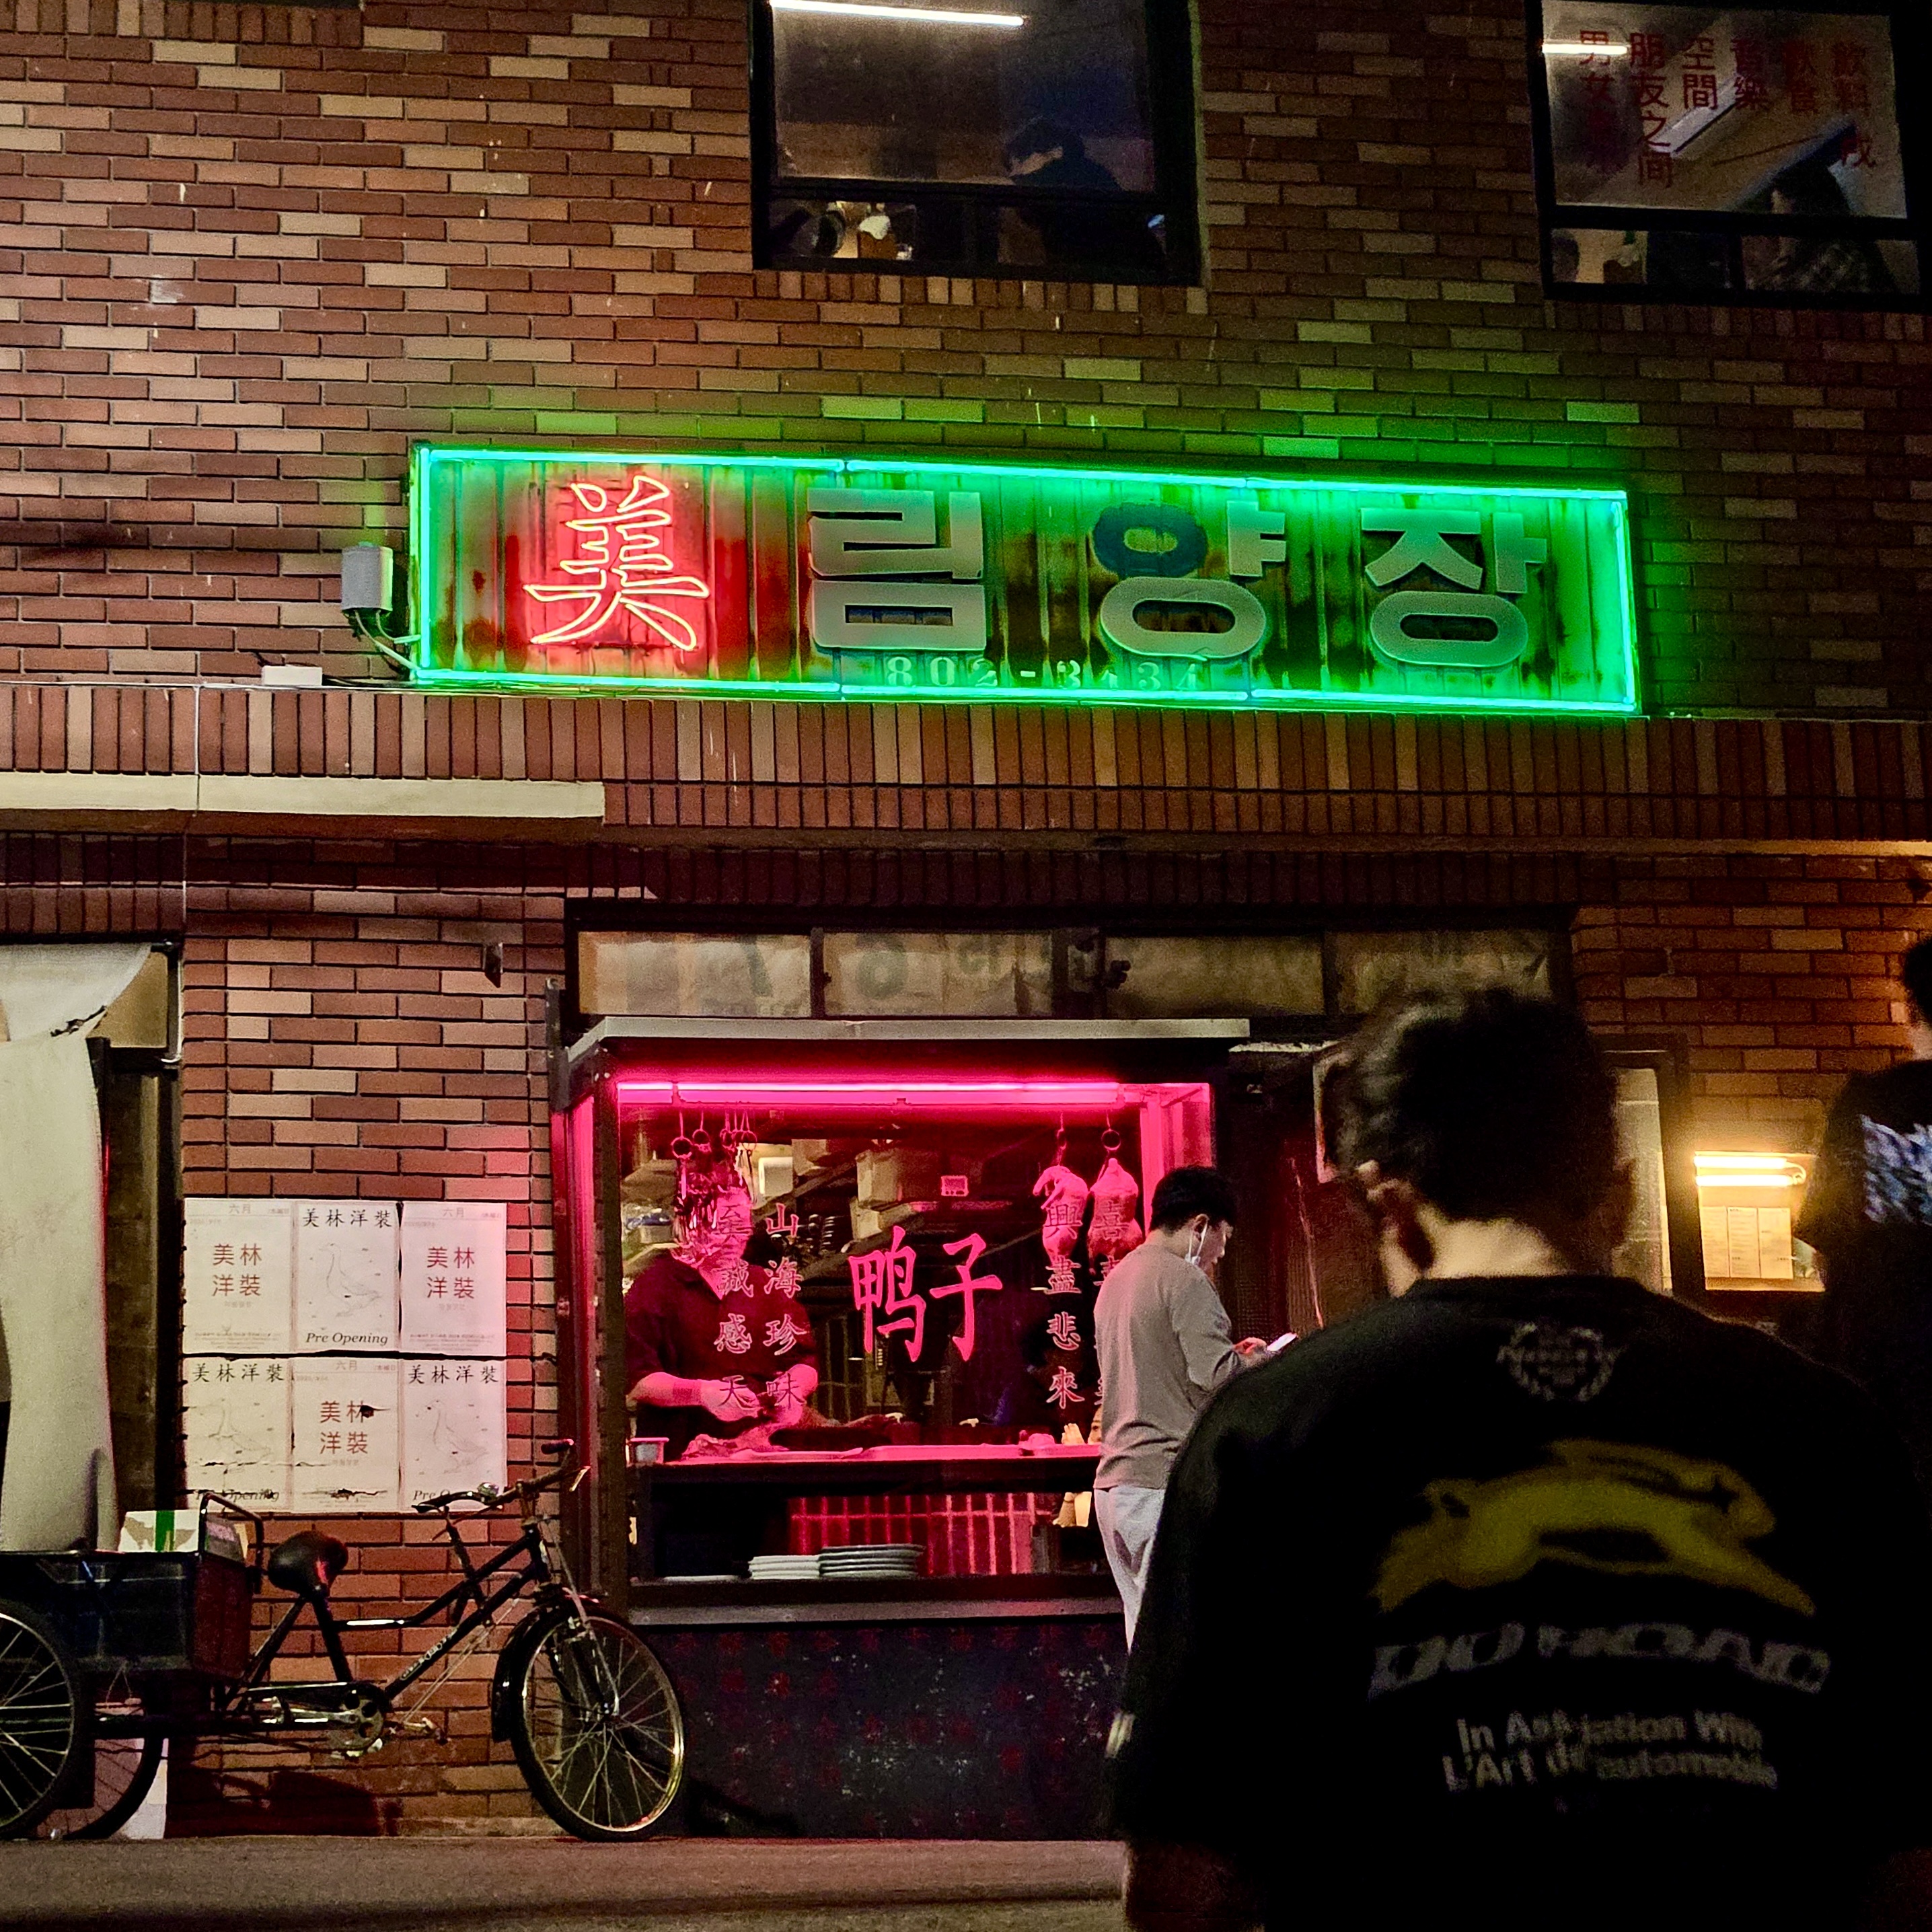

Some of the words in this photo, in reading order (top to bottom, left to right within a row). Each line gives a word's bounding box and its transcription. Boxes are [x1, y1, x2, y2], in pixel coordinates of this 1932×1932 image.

[1682, 37, 1718, 110] 空間
[302, 1208, 392, 1228] 美林洋裝
[212, 1242, 262, 1266] 美林
[426, 1246, 475, 1269] 美林
[212, 1273, 262, 1297] 洋裝
[426, 1275, 475, 1299] 洋裝
[848, 1225, 1002, 1362] 鸭子
[762, 1203, 809, 1409] 山海珍味
[1043, 1203, 1086, 1410] 興盡悲來
[305, 1332, 329, 1344] Pre
[332, 1332, 388, 1346] Opening
[192, 1362, 285, 1383] 美林洋裝
[408, 1364, 499, 1385] 美林洋裝
[320, 1400, 366, 1423] 美林
[320, 1431, 368, 1455] 洋裝
[413, 1490, 436, 1501] Pre
